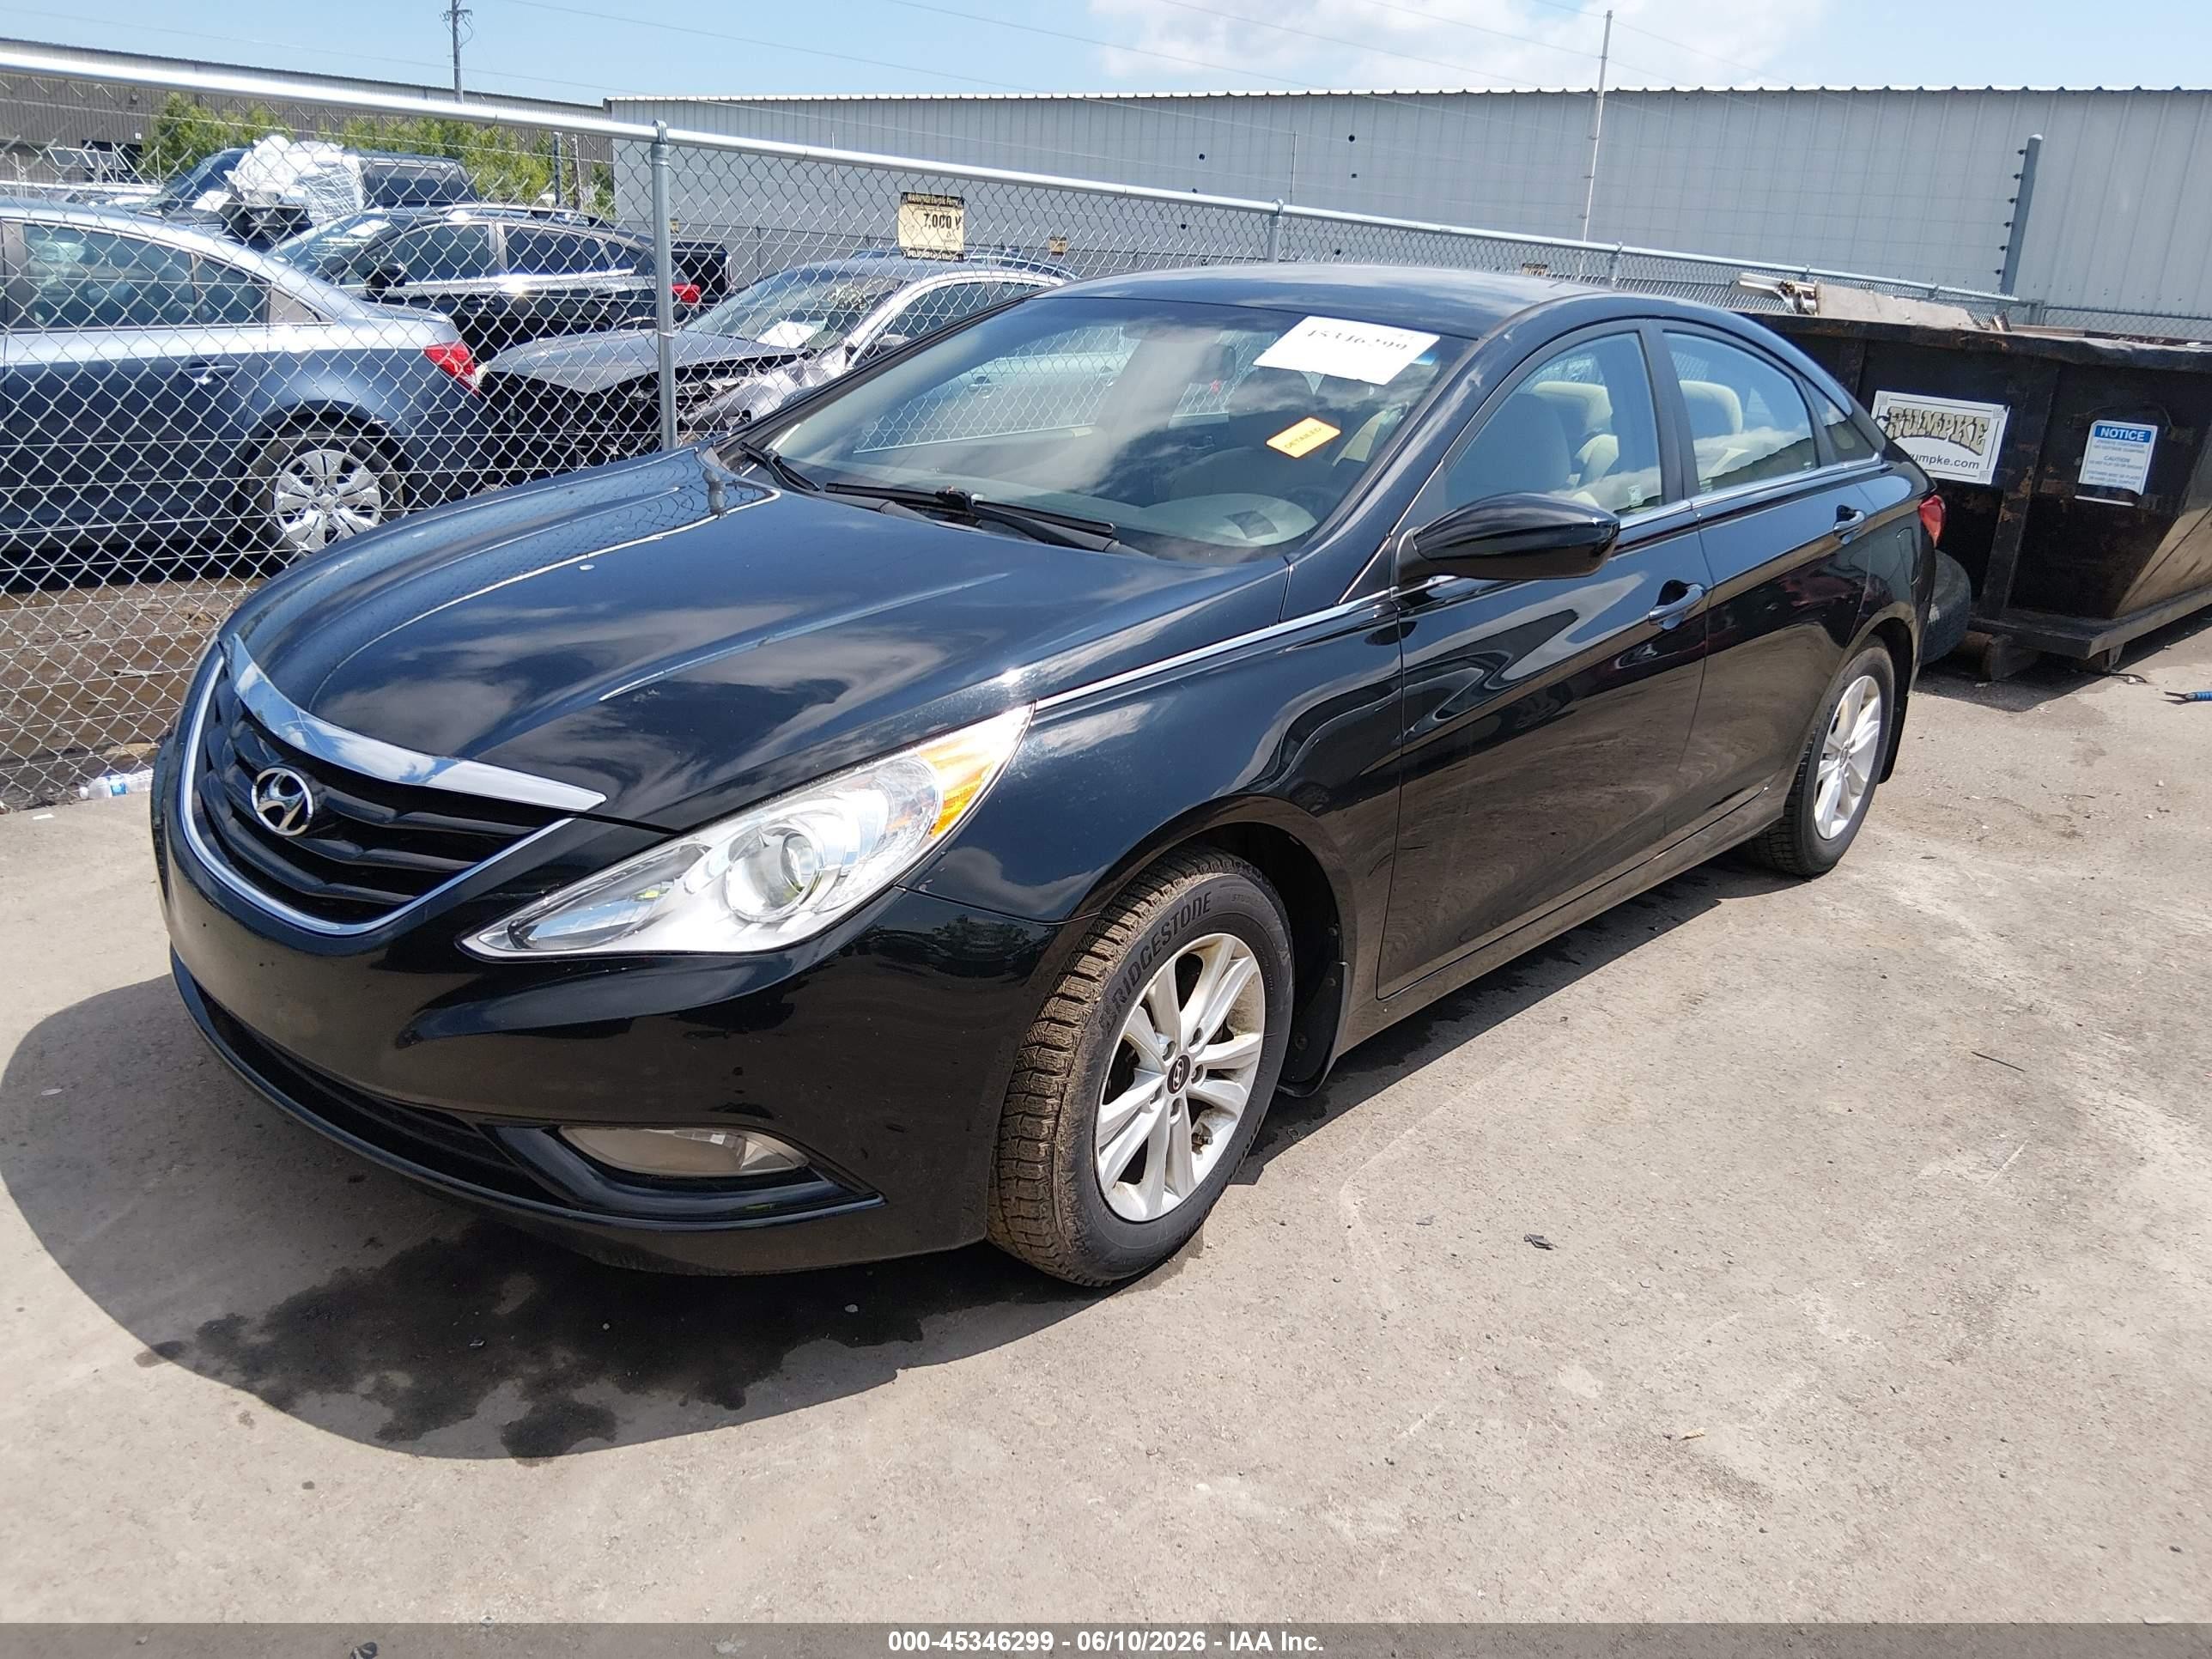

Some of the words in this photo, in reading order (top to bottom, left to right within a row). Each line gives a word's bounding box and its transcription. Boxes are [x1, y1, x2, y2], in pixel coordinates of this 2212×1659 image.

[924, 213, 951, 229] 7,000
[955, 216, 962, 230] V
[1885, 406, 1990, 456] RUMPKE
[2100, 428, 2146, 441] NOTICE
[1909, 453, 1979, 470] umpke.com
